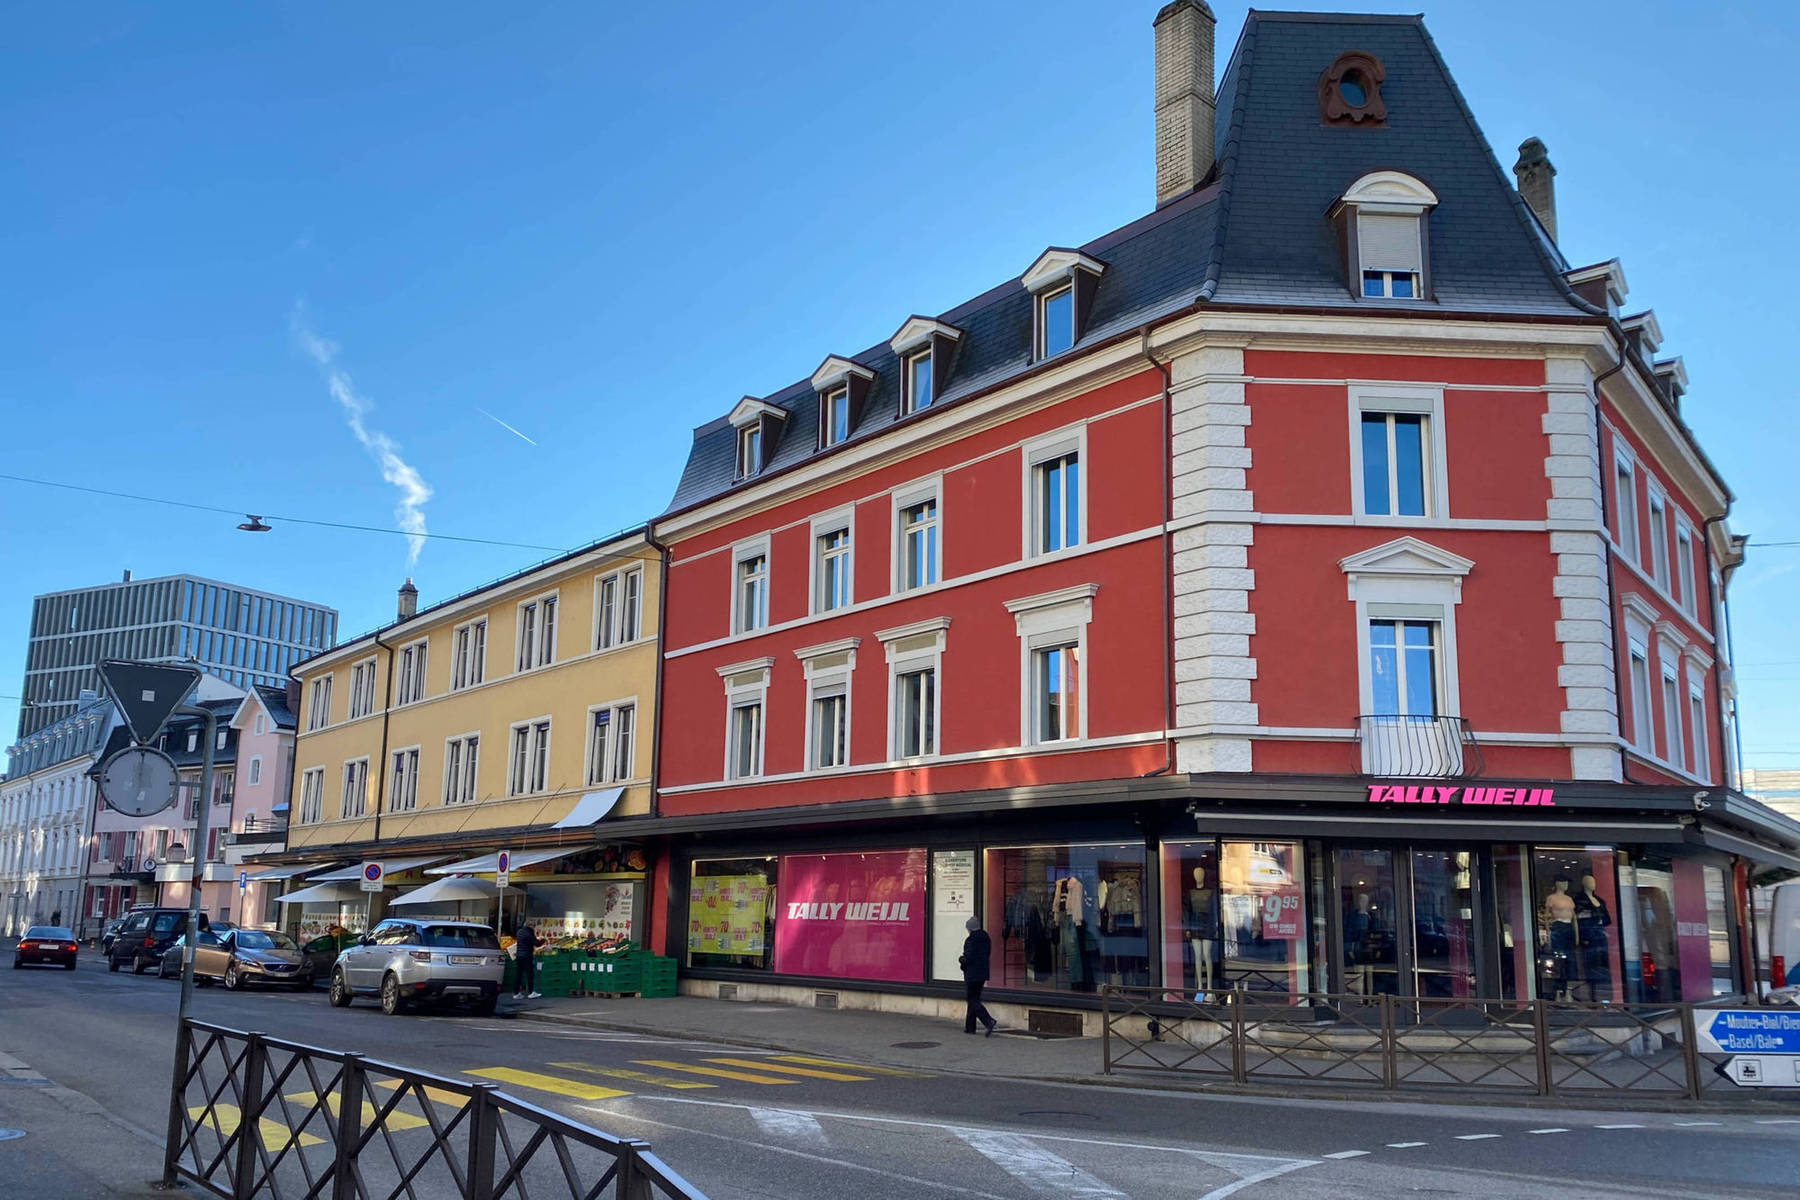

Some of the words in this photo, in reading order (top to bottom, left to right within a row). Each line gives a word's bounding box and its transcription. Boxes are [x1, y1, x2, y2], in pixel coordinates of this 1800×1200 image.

[1368, 785, 1459, 804] TALLY
[1462, 787, 1556, 806] WEIJL
[787, 902, 844, 920] TALLY
[845, 902, 910, 921] WEIJL
